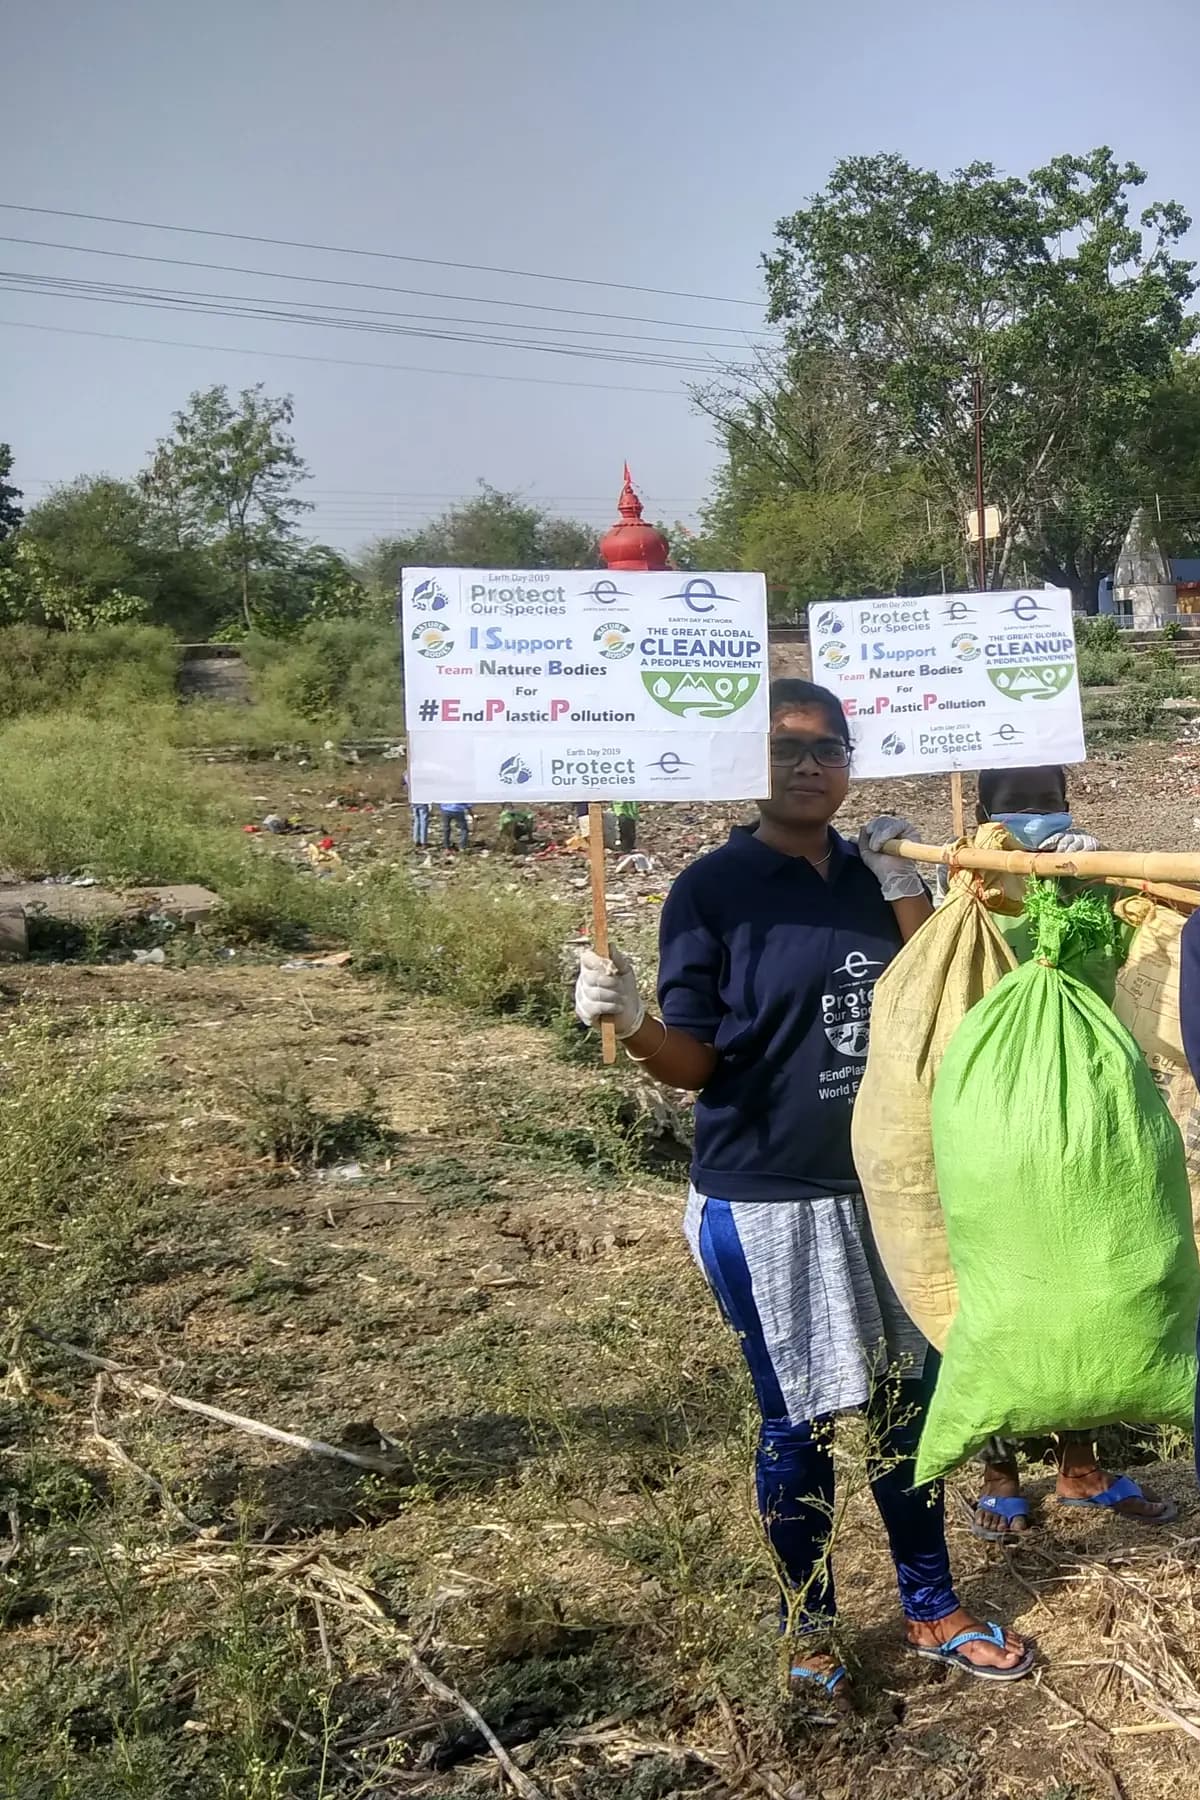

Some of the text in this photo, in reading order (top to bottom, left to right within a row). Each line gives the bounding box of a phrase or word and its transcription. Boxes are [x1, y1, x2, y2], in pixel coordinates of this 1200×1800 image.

[471, 584, 566, 603] Protect
[471, 602, 567, 617] Our Species
[860, 608, 930, 625] Protect
[647, 627, 754, 638] THE GREAT GLOBAL
[860, 624, 881, 634] Our
[885, 622, 931, 634] Species
[469, 626, 573, 654] I Support
[988, 631, 1069, 642] THE GREAT GLOBAL
[640, 637, 762, 658] CLEANUP
[861, 643, 868, 660] I
[872, 642, 937, 662] Support
[984, 638, 1073, 658] CLEANUP
[436, 660, 607, 675] Team Nature Bodies
[640, 658, 762, 669] A PEOPLE'S MOVEMENT
[838, 664, 964, 681] Team Nature Bodies
[515, 686, 538, 696] For
[896, 685, 913, 693] For
[418, 699, 635, 722] #EndPlasticPollution
[919, 730, 982, 746] Protect
[587, 748, 601, 757] Day
[601, 748, 621, 756] 2019
[920, 746, 939, 755] Our
[942, 743, 983, 755] Species
[551, 759, 635, 775] Protect
[551, 775, 636, 787] Our Species
[823, 1011, 847, 1024] Our
[819, 1083, 850, 1100] World
